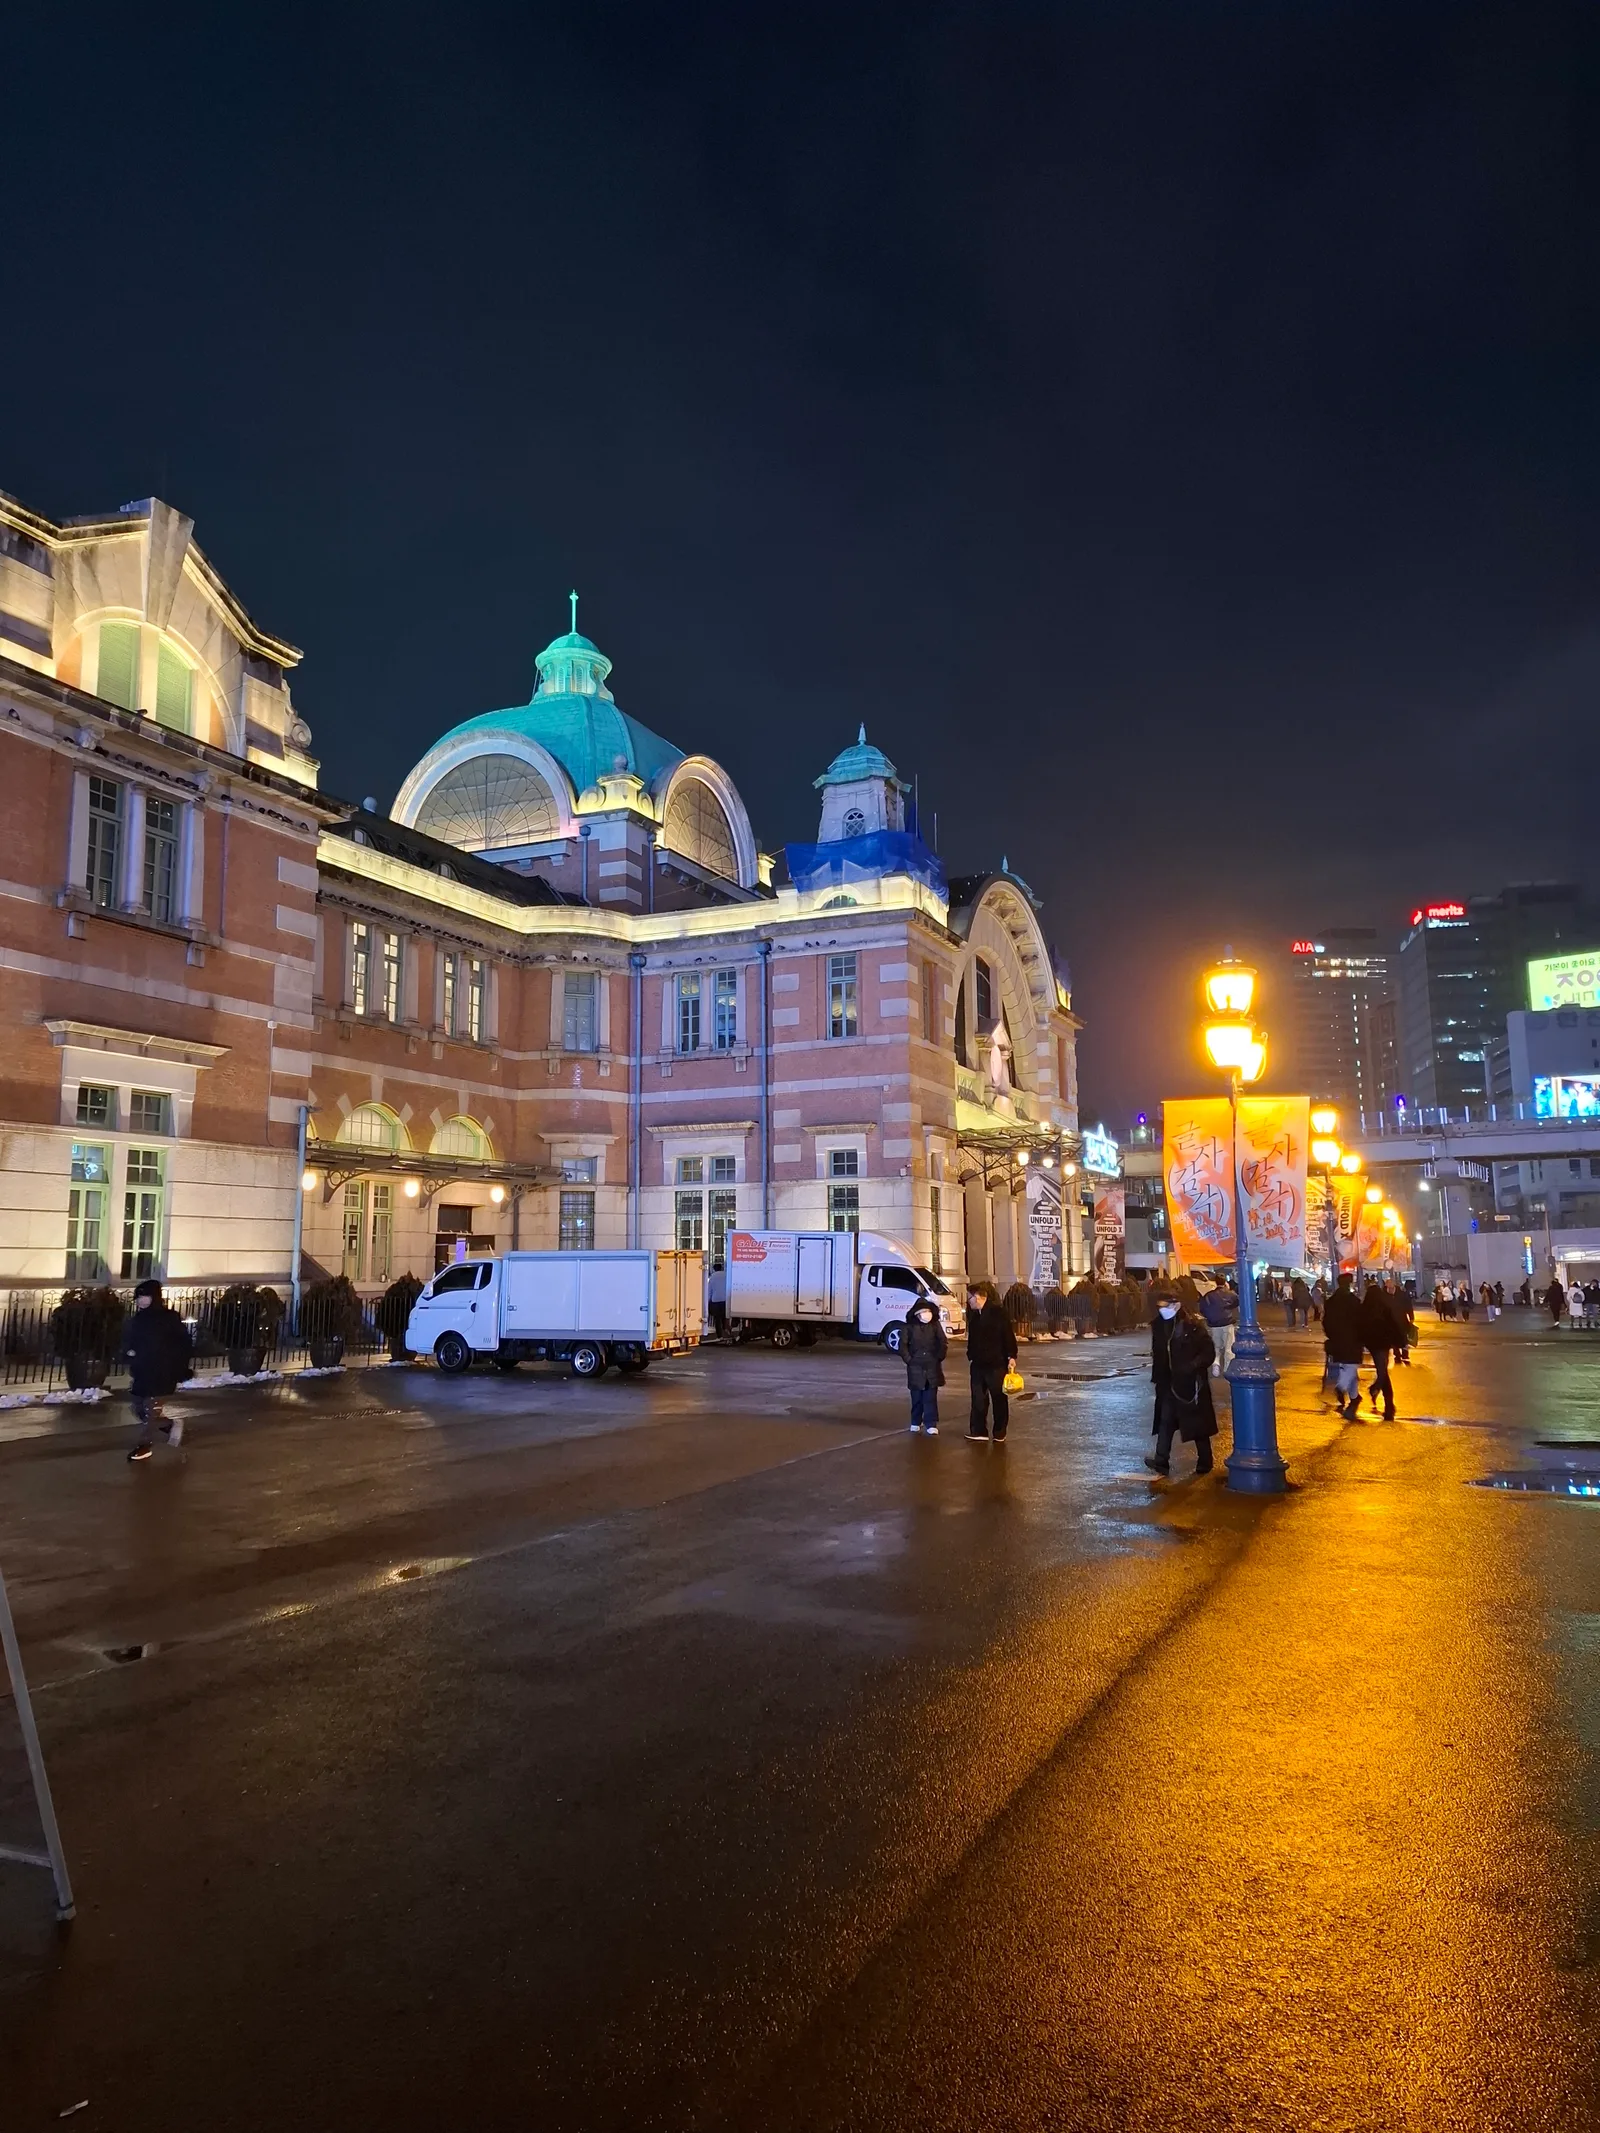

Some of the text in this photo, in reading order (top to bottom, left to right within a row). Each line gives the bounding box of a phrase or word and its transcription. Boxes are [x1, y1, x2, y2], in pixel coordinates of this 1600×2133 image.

[1428, 905, 1464, 917] meritz
[1293, 942, 1315, 953] AIA
[1340, 1196, 1351, 1230] UNFOLD
[1030, 1216, 1060, 1225] UNFOLD X
